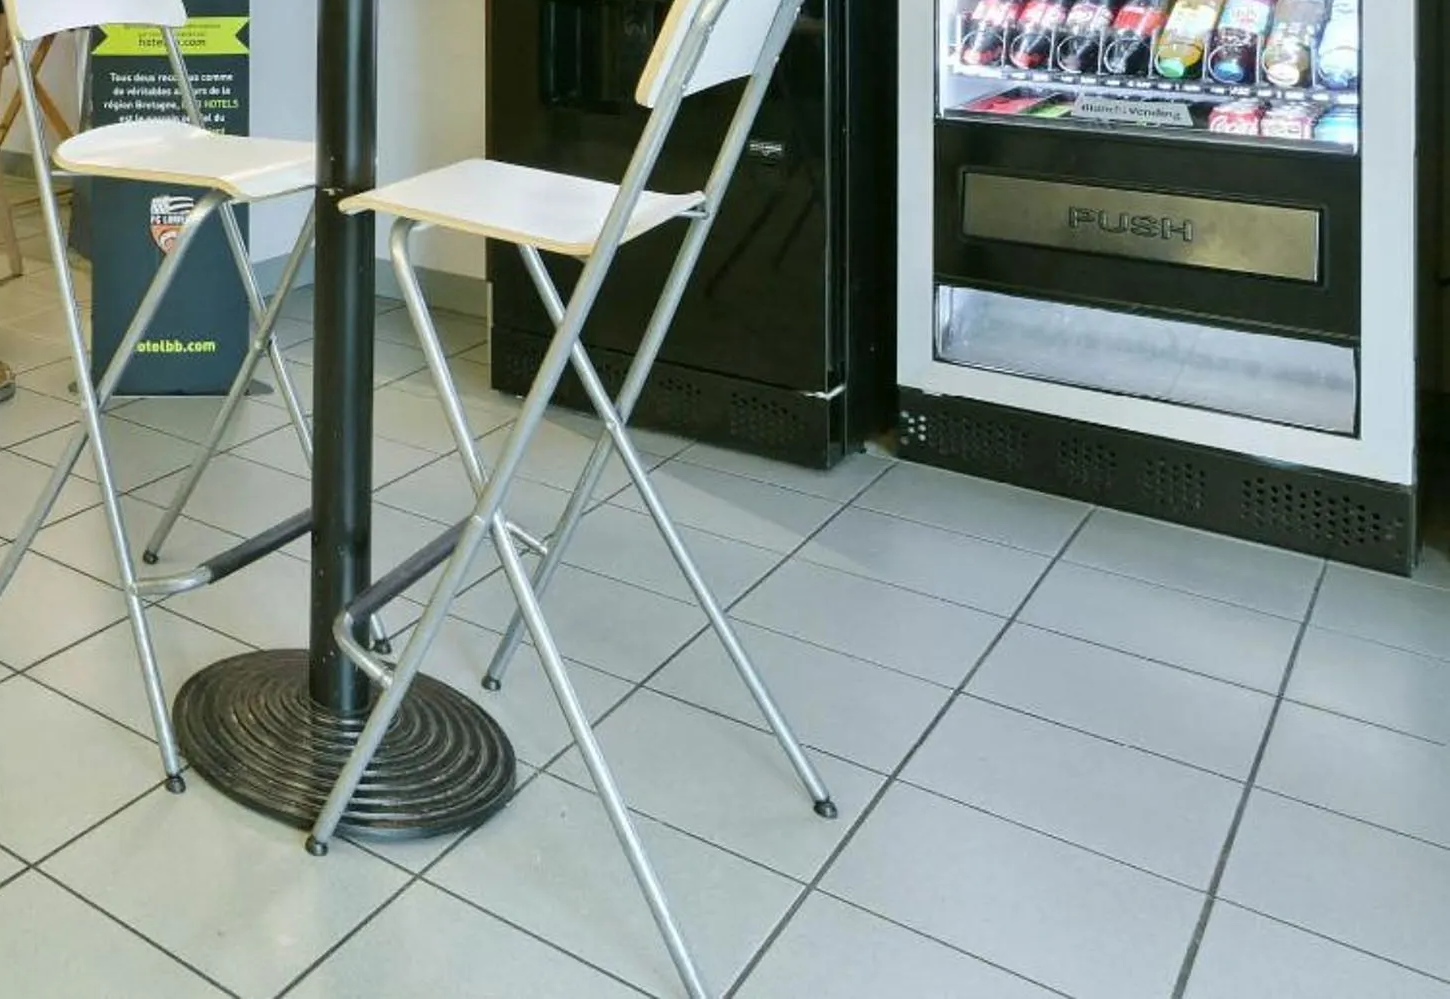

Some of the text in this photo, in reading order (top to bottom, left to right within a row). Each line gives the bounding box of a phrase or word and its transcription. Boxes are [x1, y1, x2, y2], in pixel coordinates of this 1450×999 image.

[204, 99, 239, 109] HOTELS
[1068, 205, 1194, 242] PUSH
[136, 339, 216, 353] otelbb.com
